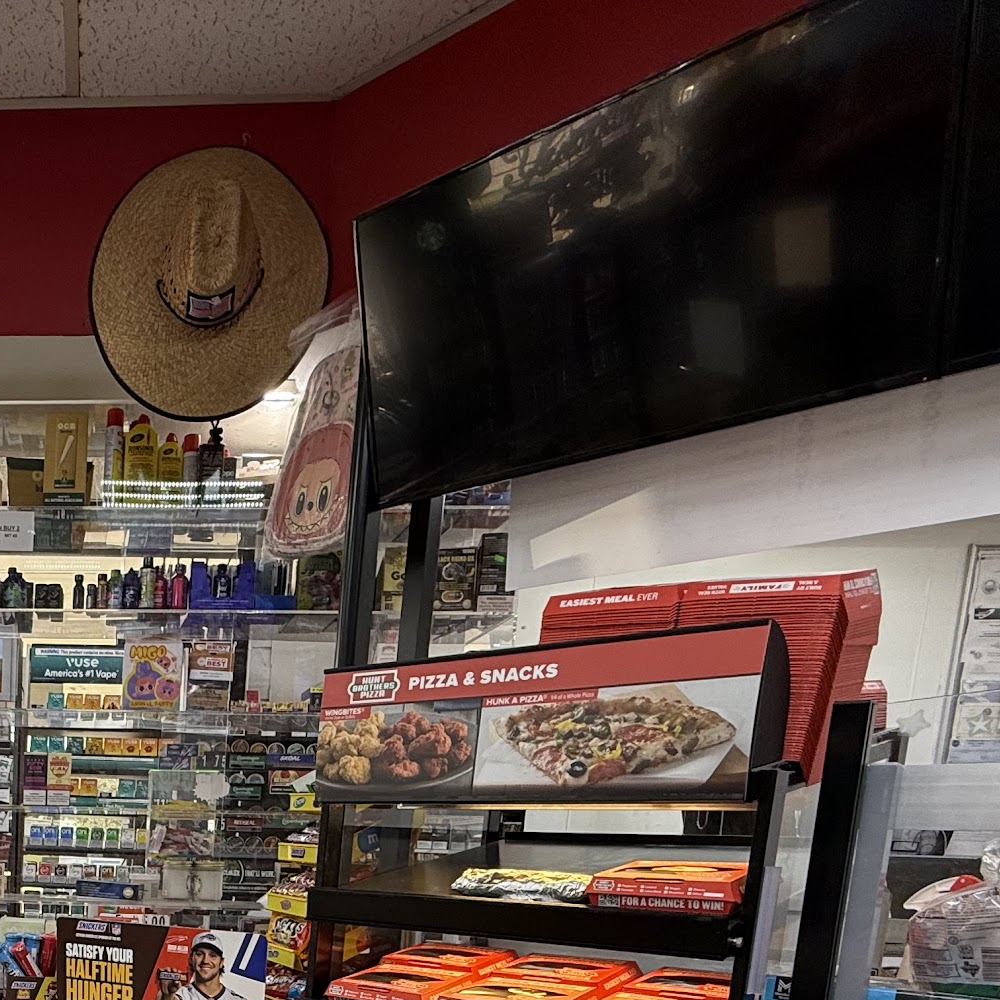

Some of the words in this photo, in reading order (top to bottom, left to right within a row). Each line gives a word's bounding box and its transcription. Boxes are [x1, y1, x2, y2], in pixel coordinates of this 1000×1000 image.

[3, 525, 15, 533] BUY
[559, 597, 603, 608] EASIEST
[604, 594, 635, 604] MEAL
[636, 591, 659, 602] EVER
[129, 645, 167, 660] MIGO
[44, 669, 83, 678] America's
[409, 673, 458, 690] PIZZA
[463, 672, 475, 686] &
[480, 664, 559, 684] SNACKS
[362, 675, 387, 684] HUNT
[352, 682, 396, 692] BROTHERS
[360, 690, 386, 699] PIZZA
[486, 697, 510, 706] HUNK
[621, 897, 639, 906] FOR
[640, 898, 647, 906] A
[648, 898, 685, 909] CHANCE
[687, 900, 700, 909] TO
[701, 901, 724, 910] WIN!
[78, 921, 106, 931] SNICKERS
[65, 943, 105, 960] SATISFY
[106, 946, 134, 963] YOUR
[65, 957, 134, 985] HALFTIME
